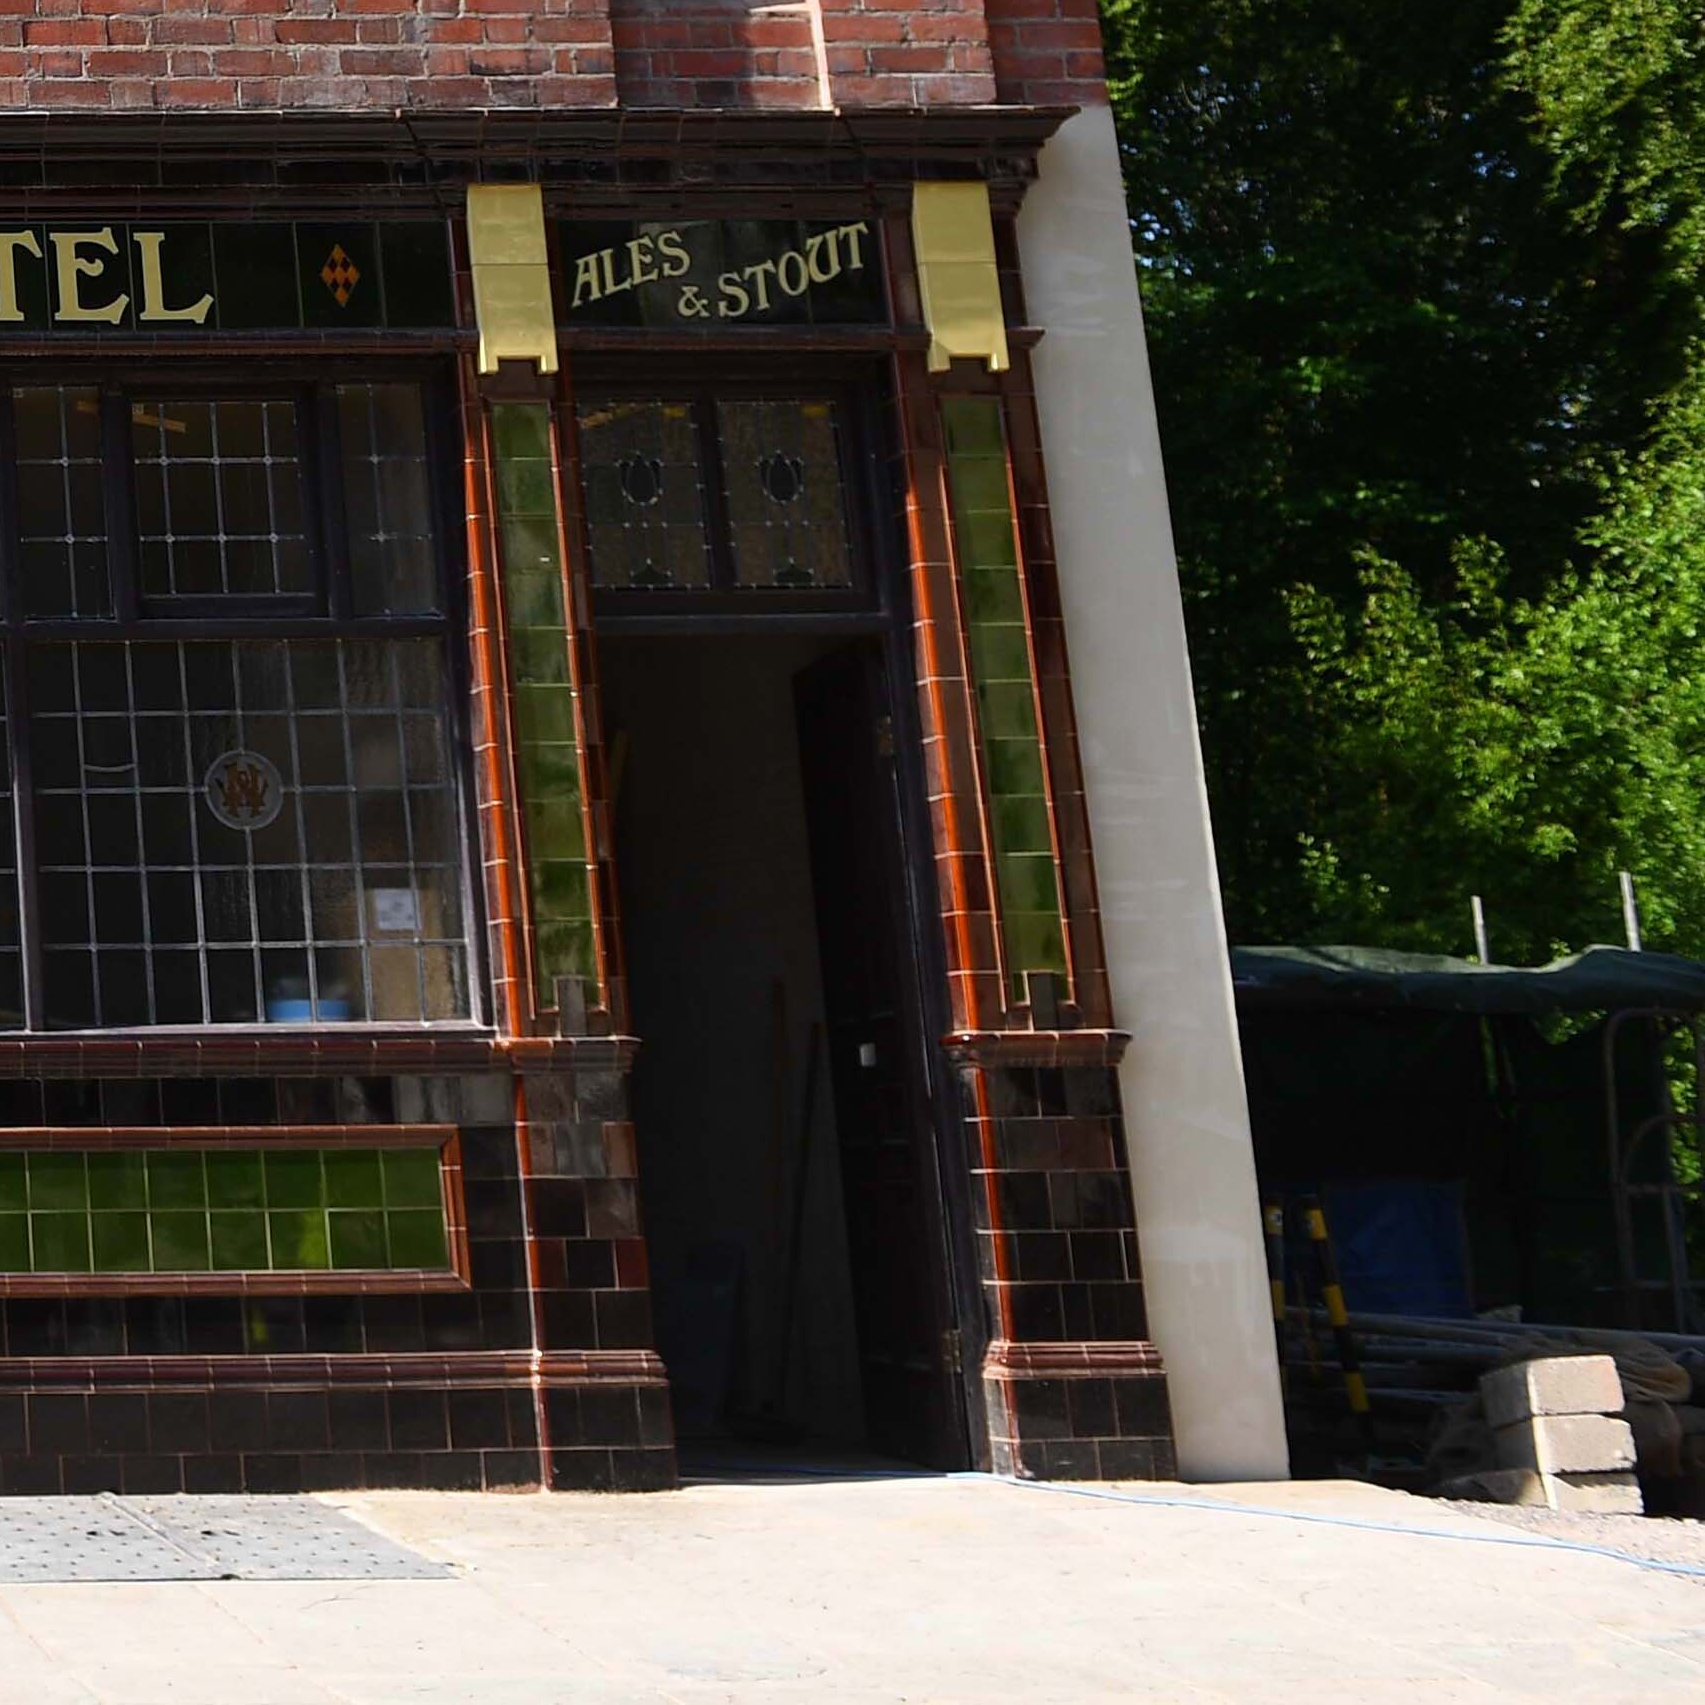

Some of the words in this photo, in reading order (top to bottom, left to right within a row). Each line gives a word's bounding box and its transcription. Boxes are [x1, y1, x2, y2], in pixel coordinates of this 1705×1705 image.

[571, 230, 691, 308] ALES
[677, 285, 711, 318] &
[717, 221, 869, 318] STOUT
